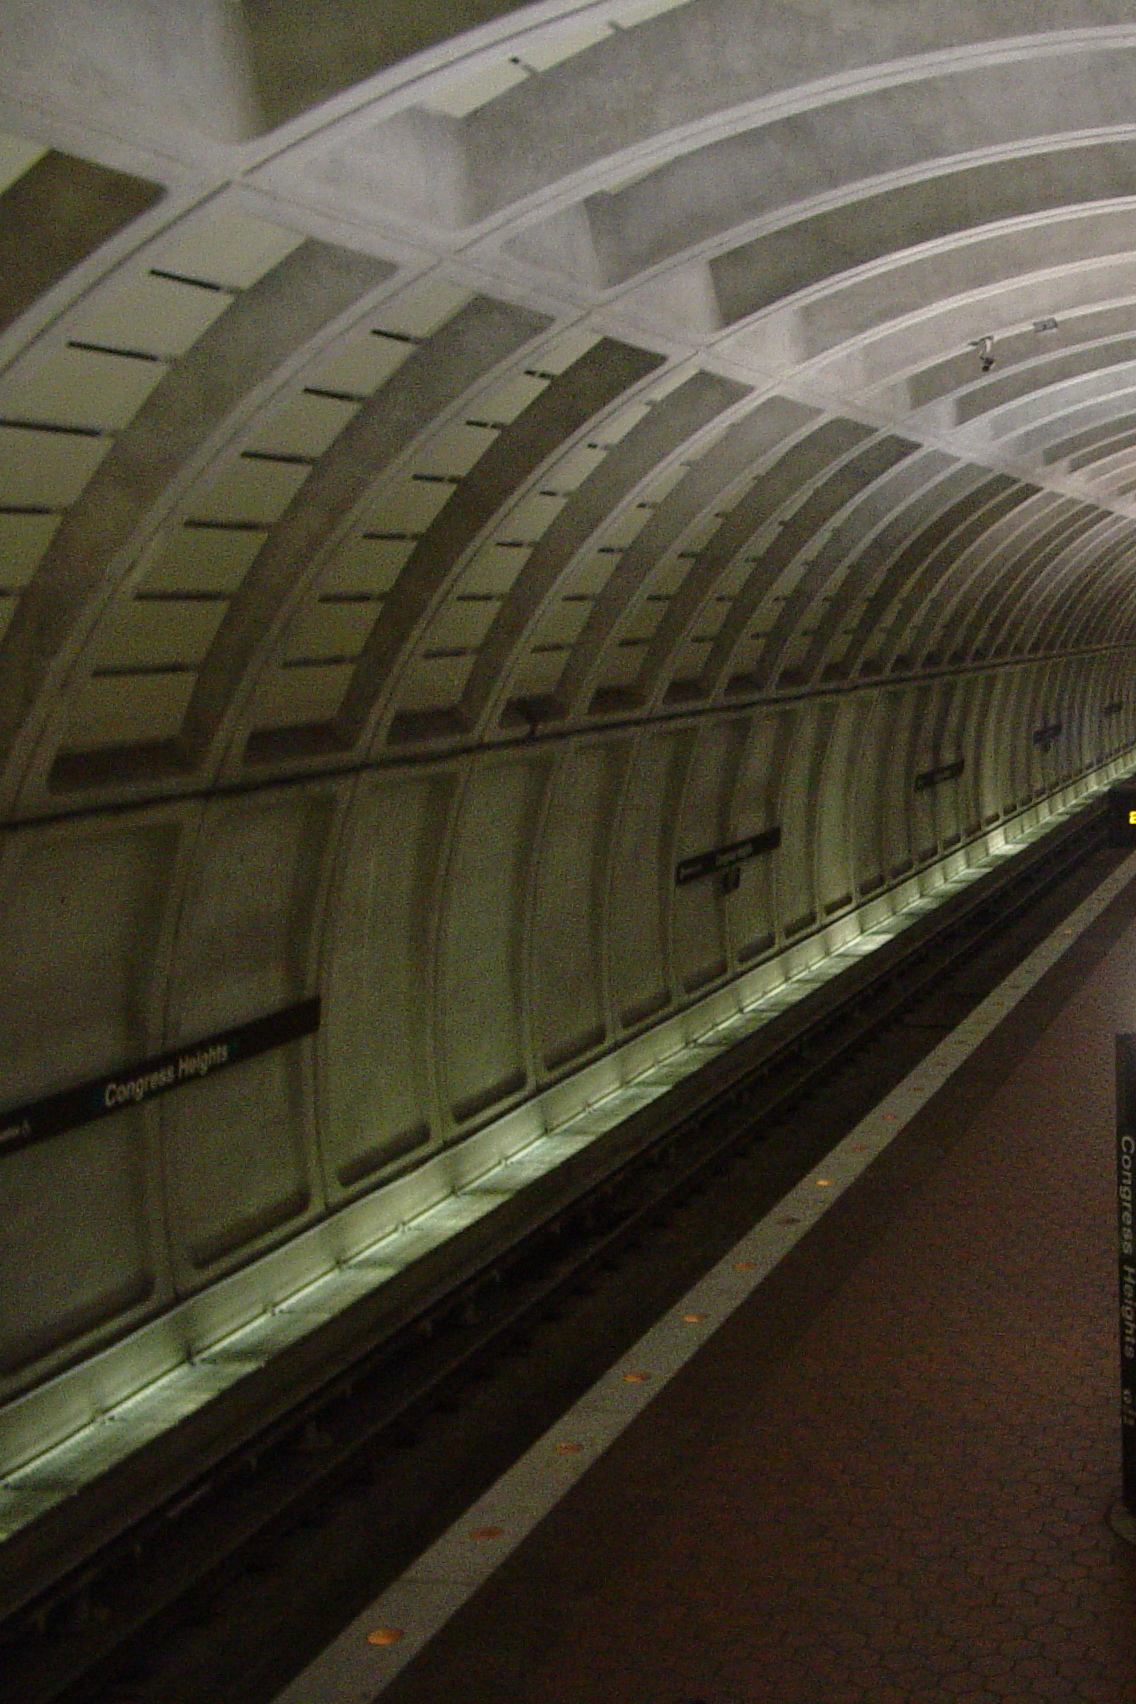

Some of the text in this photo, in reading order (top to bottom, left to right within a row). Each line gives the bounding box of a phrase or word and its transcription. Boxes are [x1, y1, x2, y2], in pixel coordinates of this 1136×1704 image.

[104, 1043, 228, 1107] Congress Heights
[1118, 1135, 1136, 1359] Congress Heights
